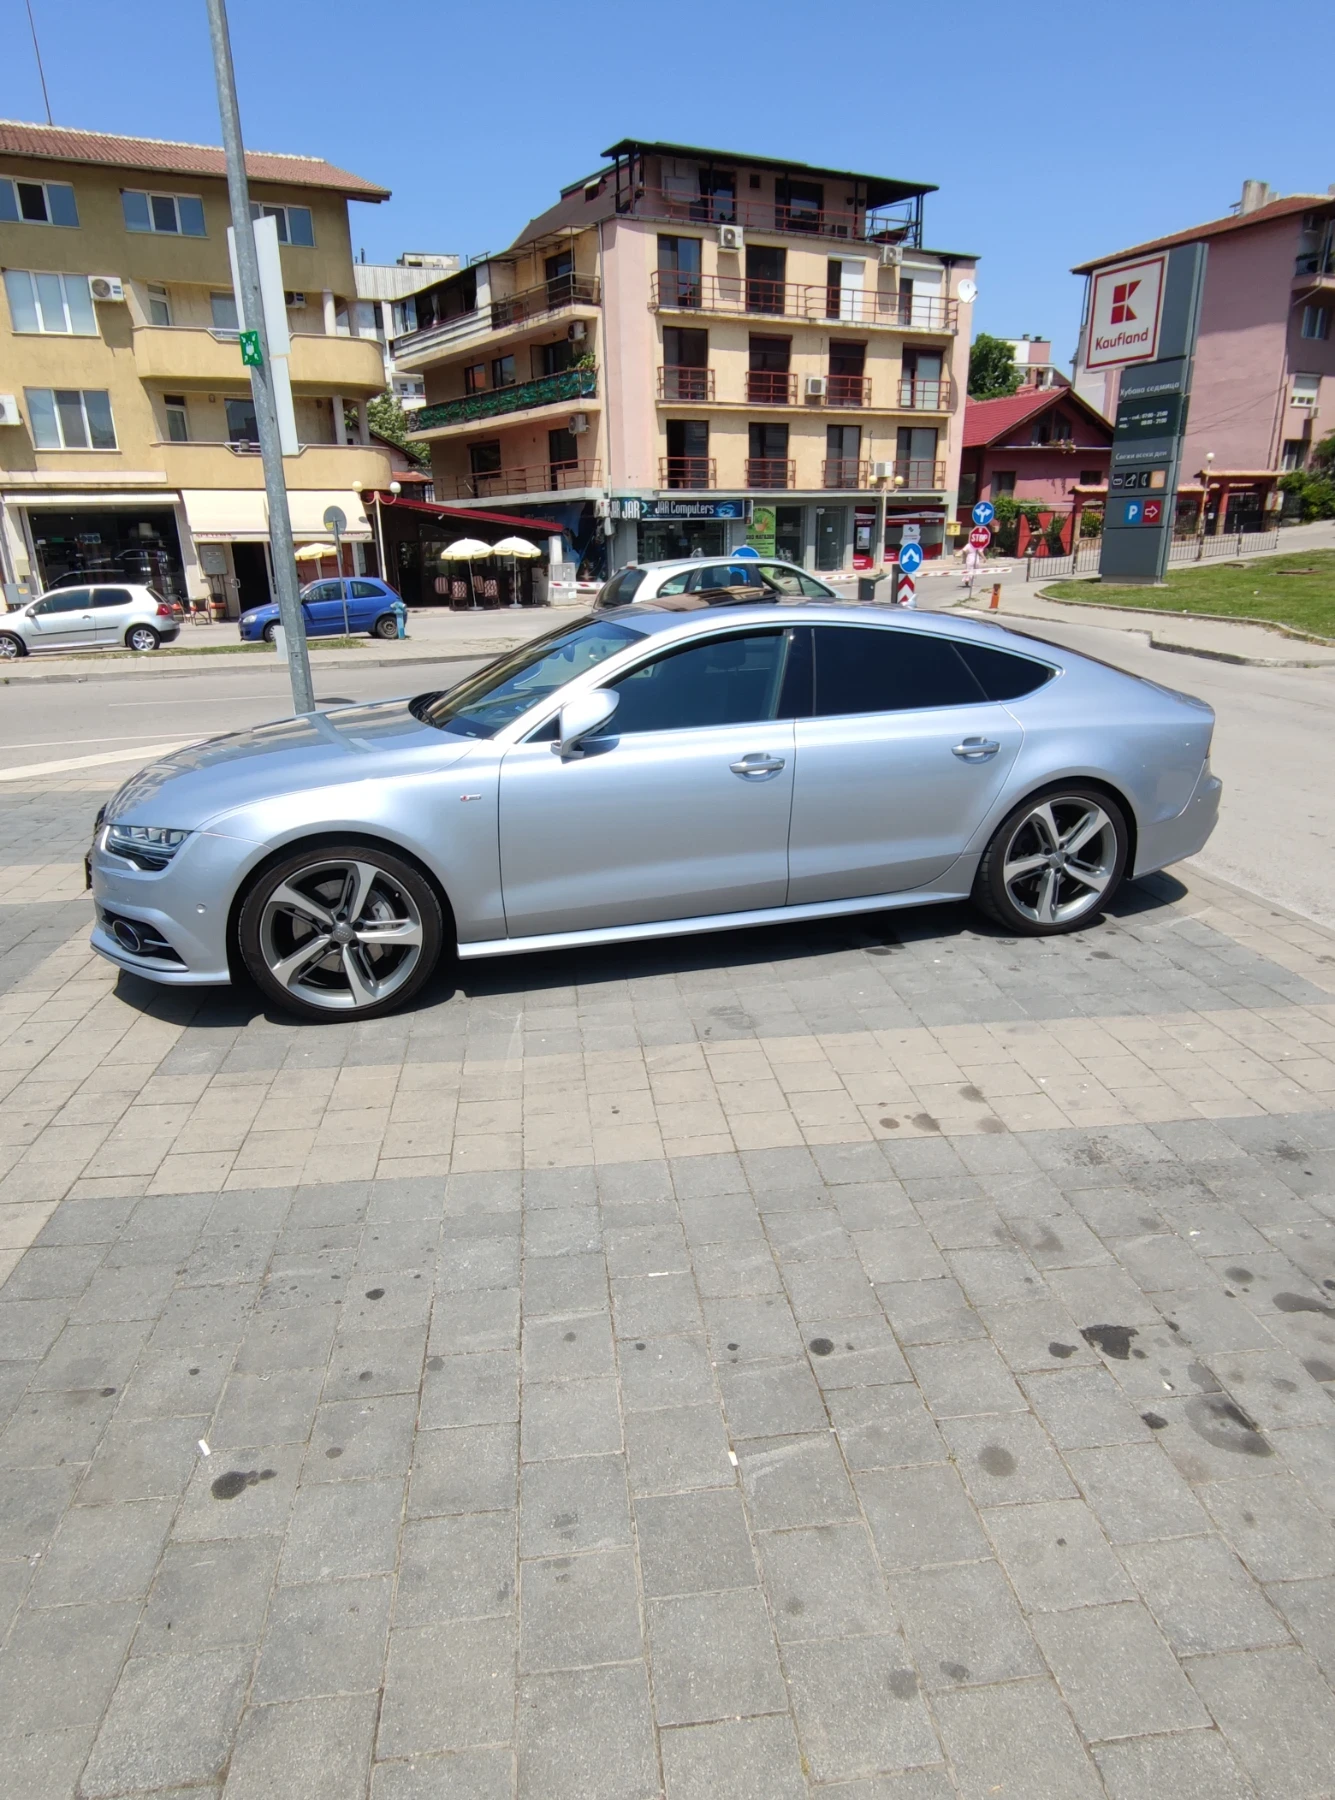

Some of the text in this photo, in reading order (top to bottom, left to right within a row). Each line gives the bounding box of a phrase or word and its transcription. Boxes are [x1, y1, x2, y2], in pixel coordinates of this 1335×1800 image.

[1095, 327, 1149, 351] Kaufland
[1146, 382, 1180, 394] седмица
[622, 501, 640, 519] JAR
[655, 501, 715, 518] JAR Computers
[1128, 505, 1138, 520] P
[970, 533, 988, 543] STOP
